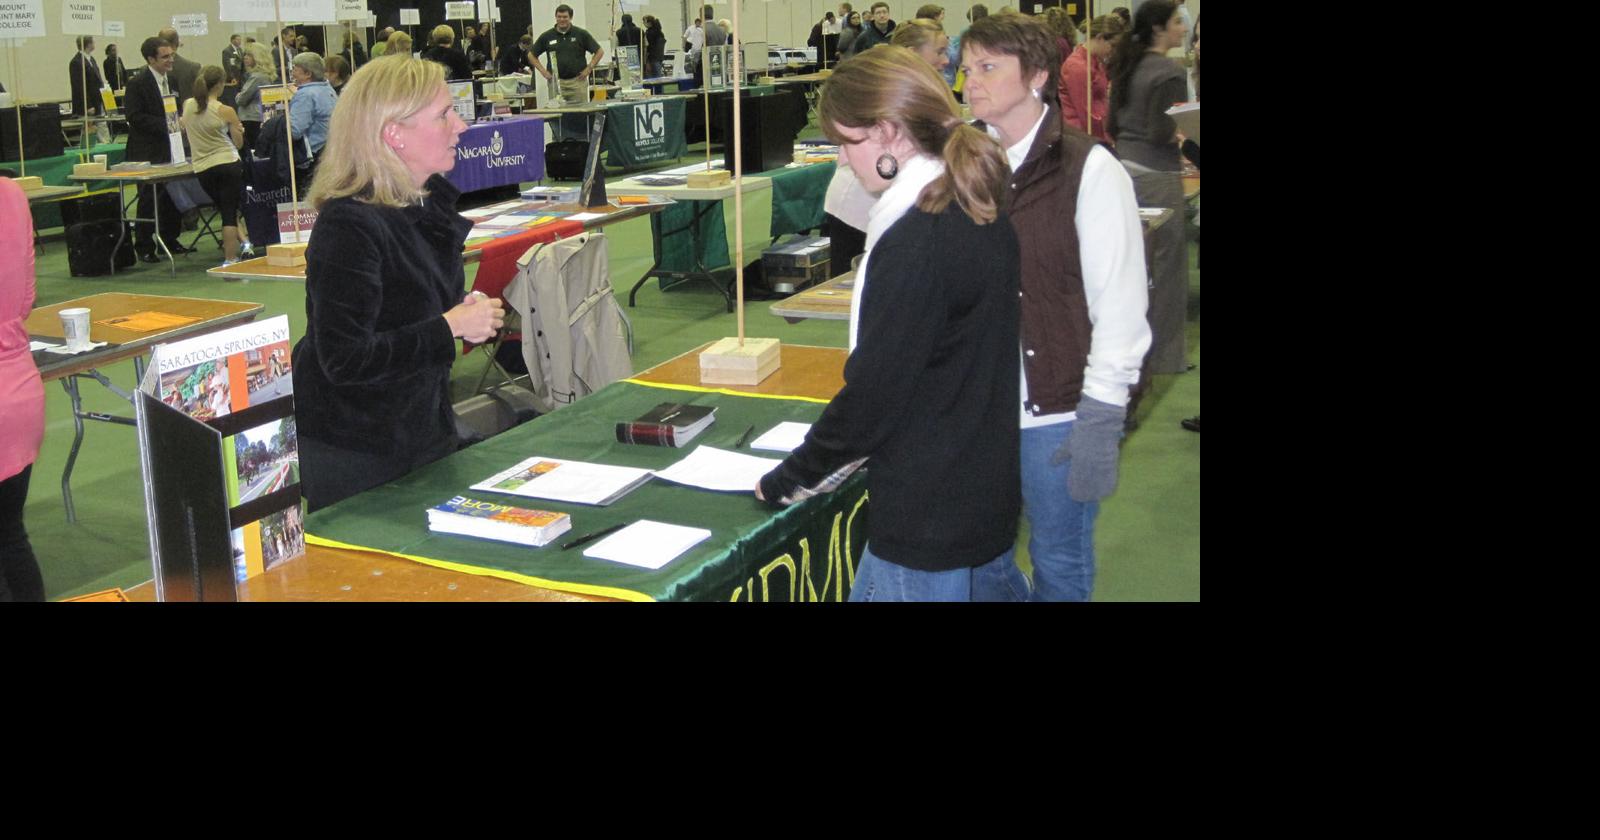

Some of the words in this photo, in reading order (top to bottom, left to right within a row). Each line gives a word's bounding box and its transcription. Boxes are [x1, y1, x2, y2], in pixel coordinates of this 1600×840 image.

[15, 12, 36, 20] MARY
[458, 145, 492, 160] NIAGARA
[486, 154, 526, 169] UNIVERSITY
[245, 186, 292, 204] Nazareth
[160, 345, 225, 371] SARATOGA
[272, 328, 288, 340] NY
